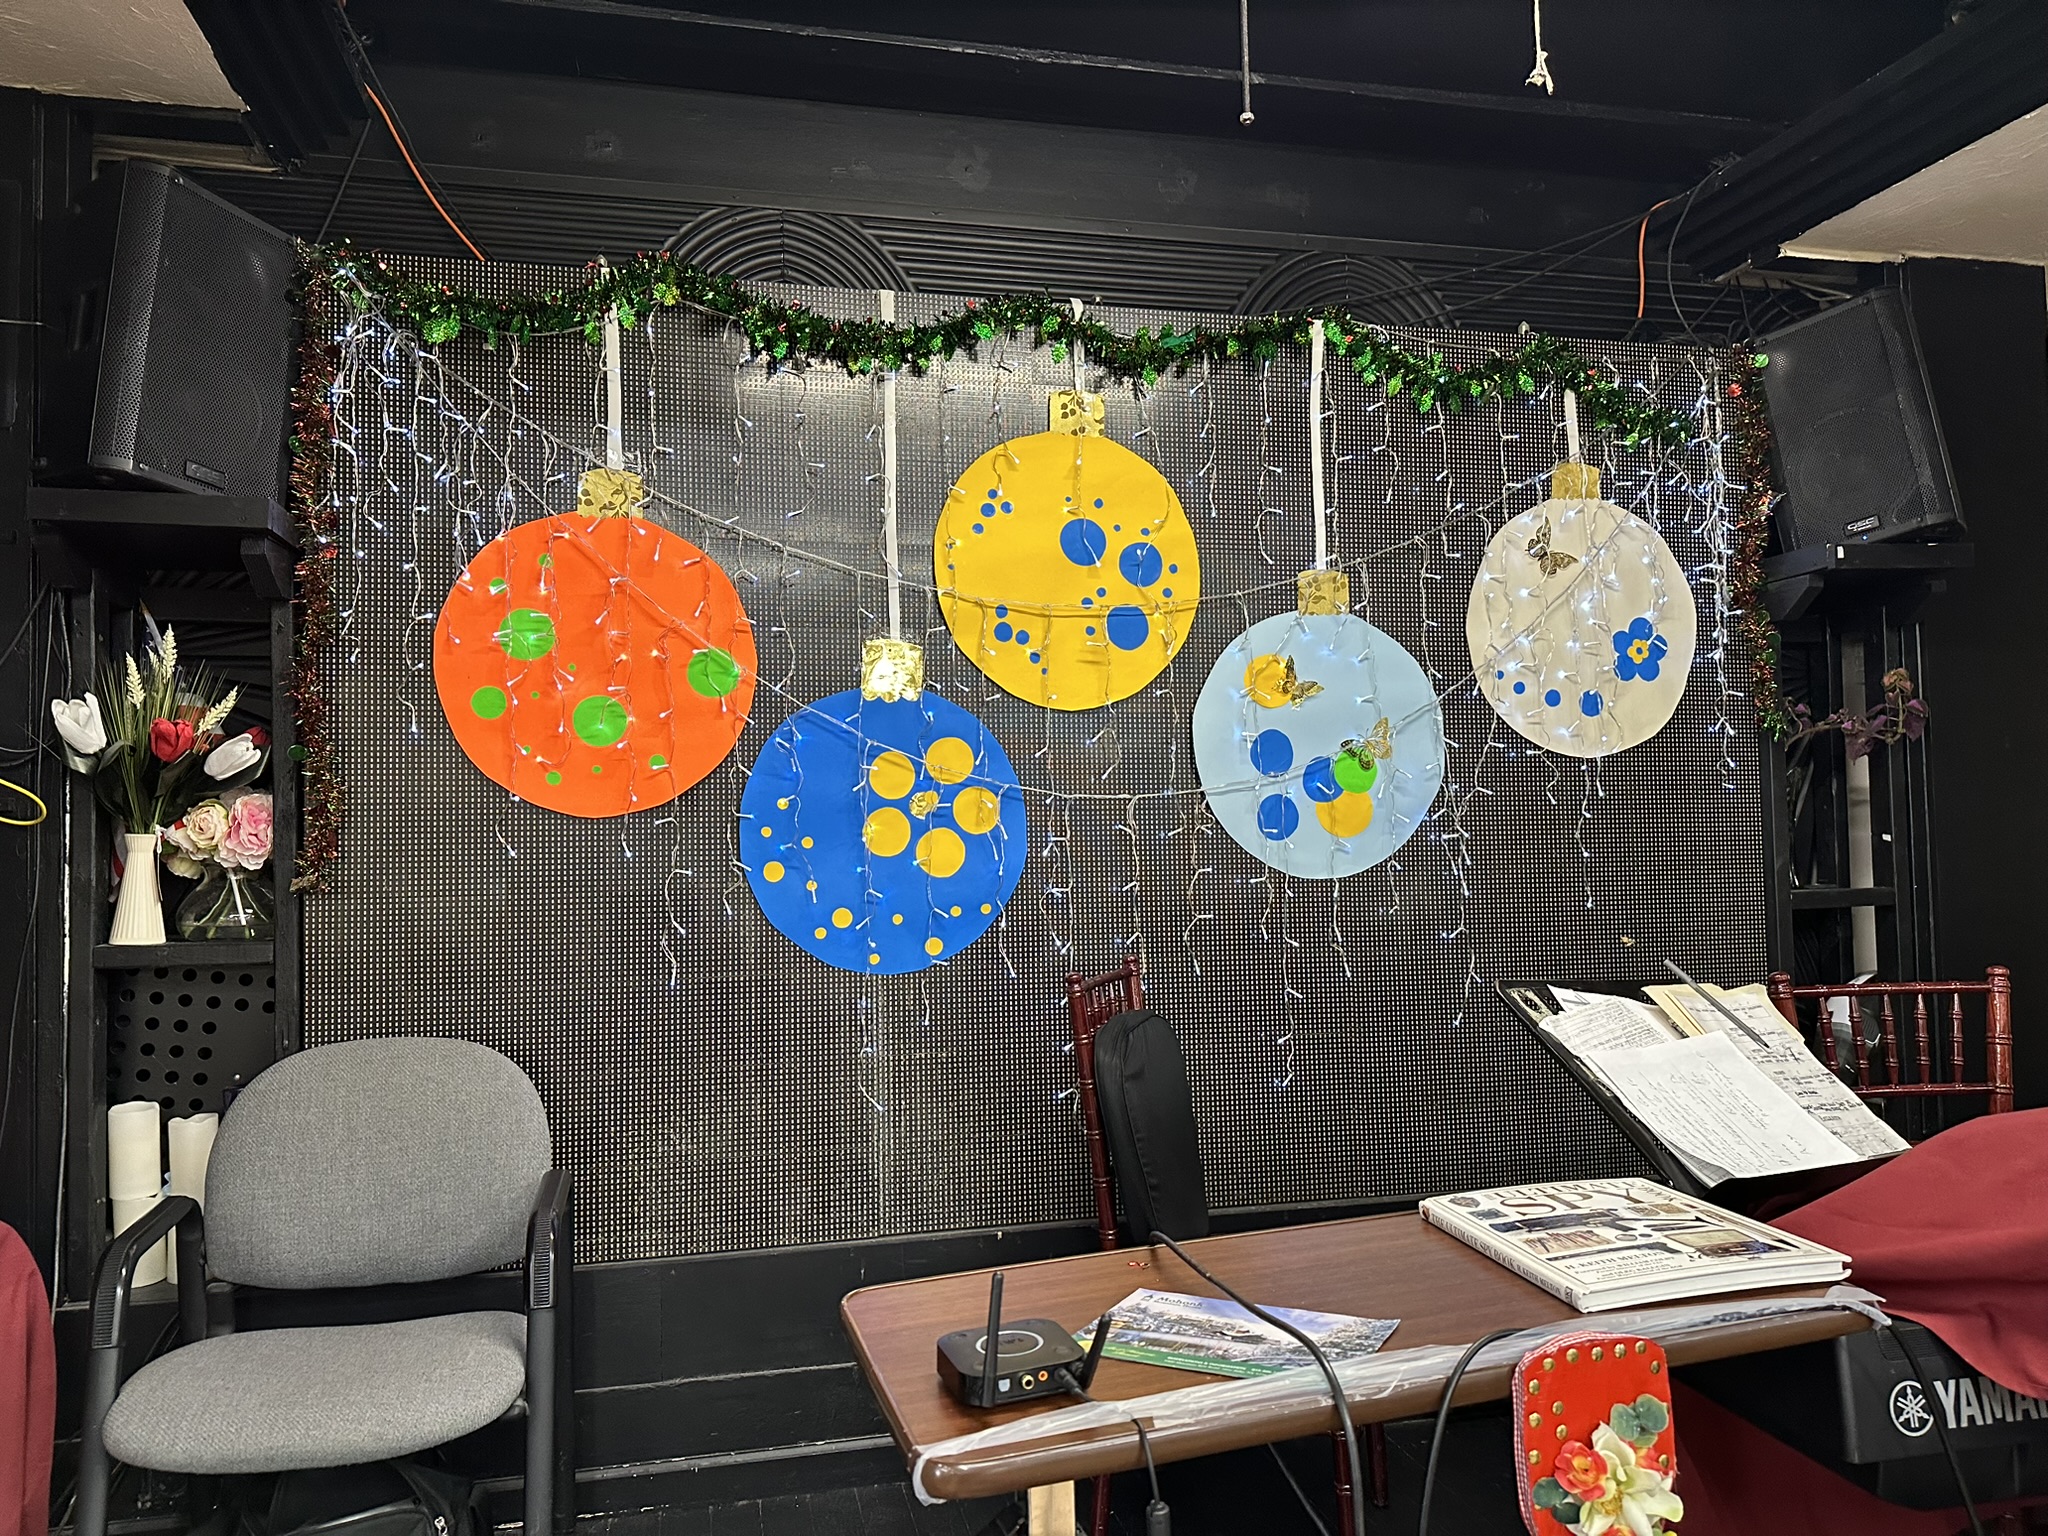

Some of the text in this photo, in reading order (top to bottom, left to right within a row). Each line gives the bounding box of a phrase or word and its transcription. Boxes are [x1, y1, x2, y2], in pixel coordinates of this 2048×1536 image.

[1847, 517, 1875, 531] QSC
[1494, 1181, 1639, 1199] ULTIMATE
[1500, 1187, 1654, 1217] SPY
[1431, 1213, 1444, 1227] THE
[1446, 1222, 1479, 1250] ULTIMATE
[1480, 1241, 1494, 1257] SPY
[1493, 1249, 1517, 1271] BOOK
[1579, 1257, 1617, 1268] KEITH
[1616, 1250, 1666, 1261] MELTON
[1157, 1297, 1203, 1307] Mohonk
[1933, 1376, 2048, 1429] YAMA
